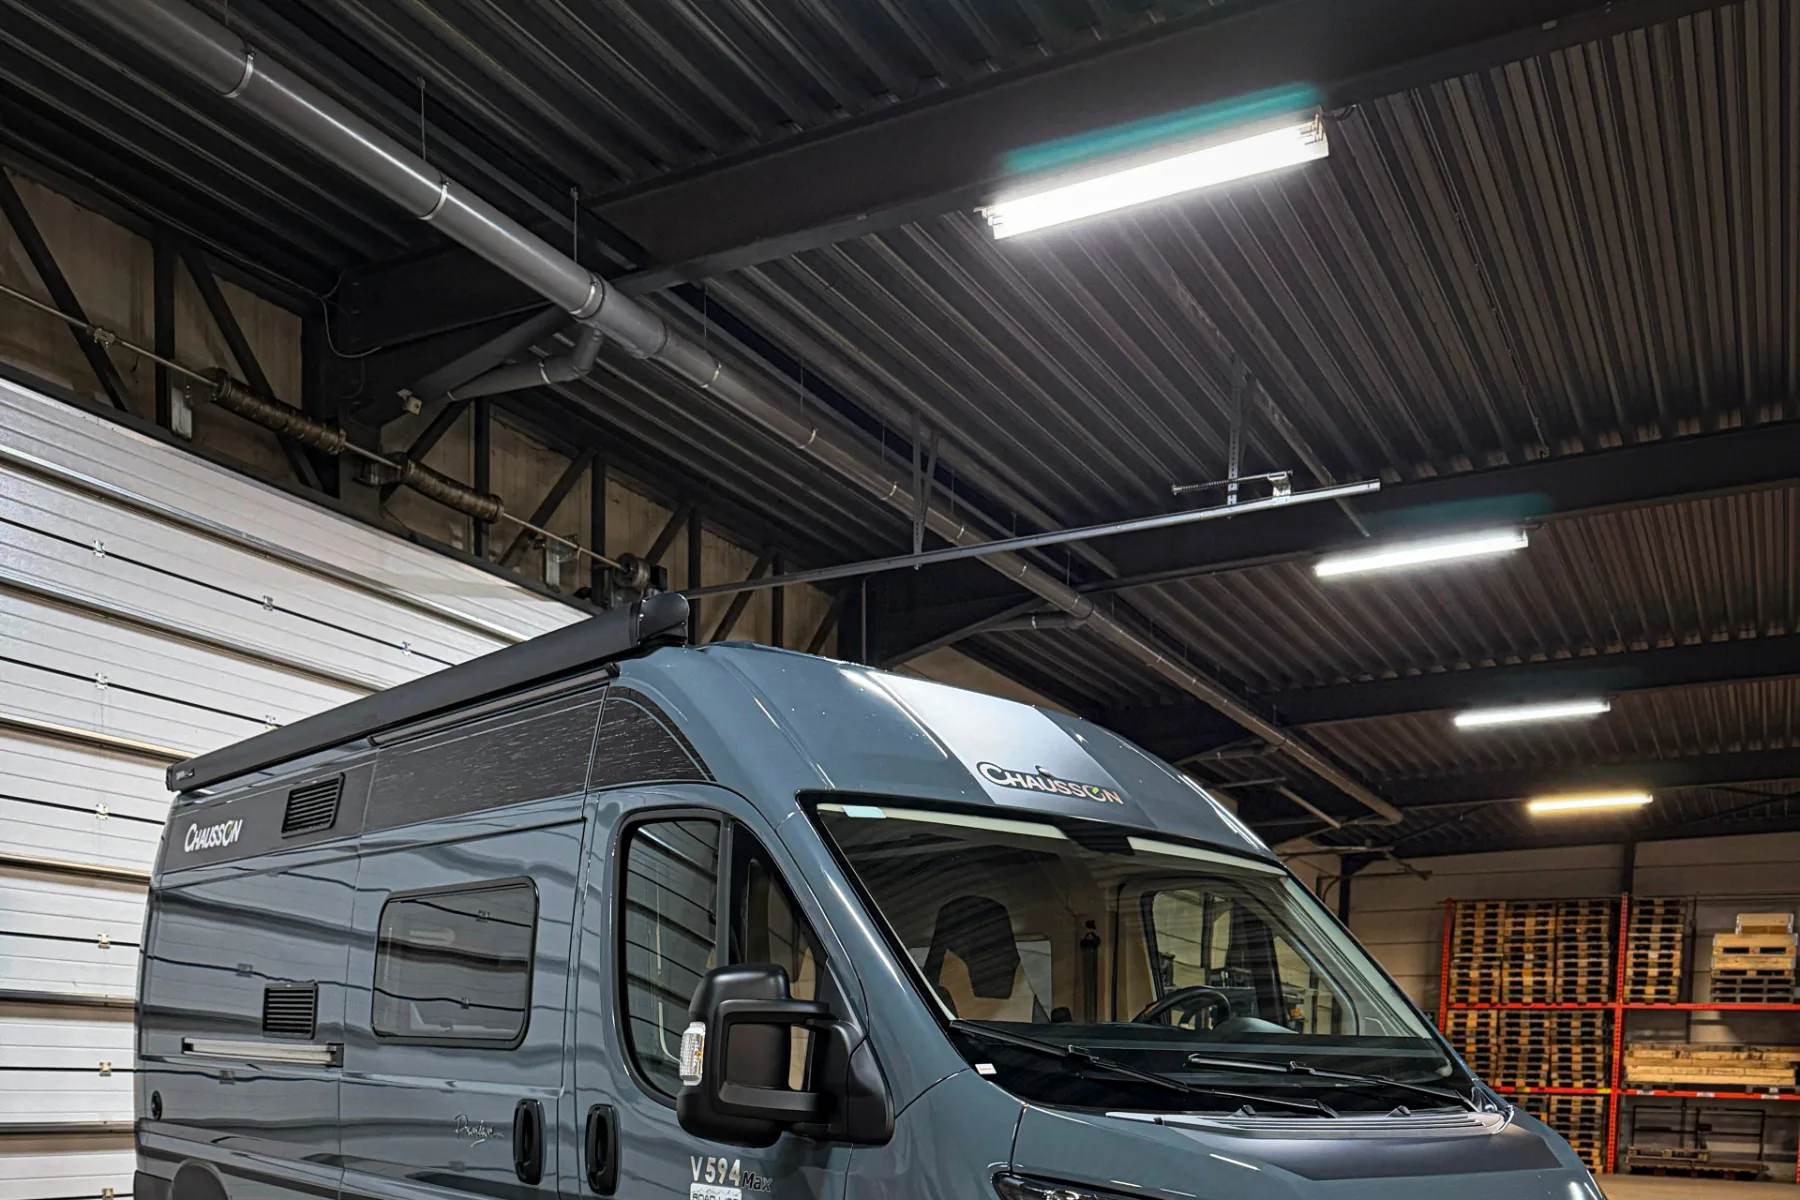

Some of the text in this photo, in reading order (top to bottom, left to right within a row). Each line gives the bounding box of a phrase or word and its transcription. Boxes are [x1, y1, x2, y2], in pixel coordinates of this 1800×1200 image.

[976, 761, 1125, 806] CHAUSSON
[184, 819, 243, 853] CHAUSSON
[741, 1170, 773, 1193] Max
